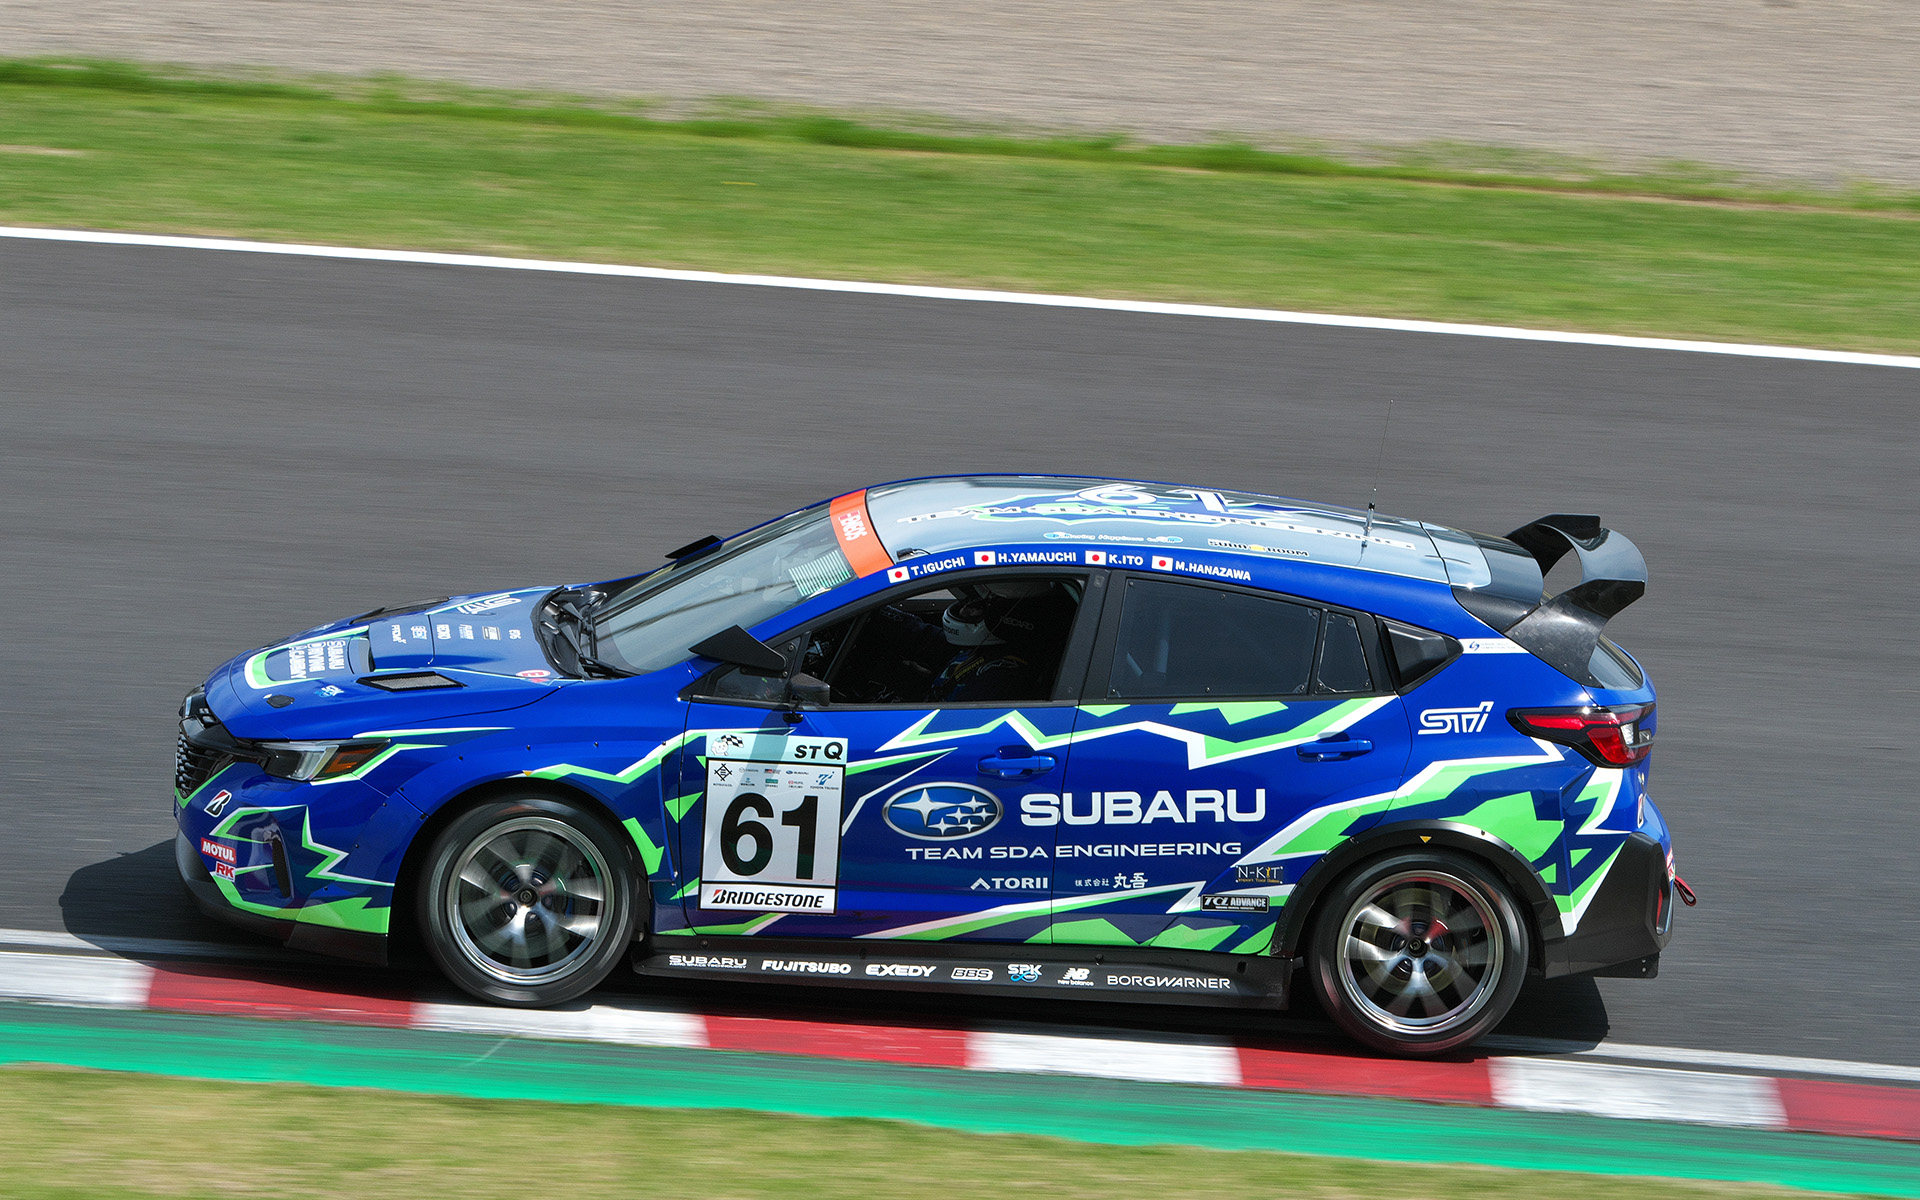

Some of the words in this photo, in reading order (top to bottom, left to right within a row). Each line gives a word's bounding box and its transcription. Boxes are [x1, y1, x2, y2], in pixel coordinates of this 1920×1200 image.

[998, 552, 1076, 563] H.YAMAUCHI
[1109, 554, 1143, 566] K.ITO
[911, 556, 965, 576] T.IGUCHI
[1175, 561, 1252, 581] M.HANAZAWA
[1020, 788, 1266, 827] SUBARU
[720, 792, 819, 880] 61
[202, 841, 235, 862] MOTUL
[905, 847, 983, 860] TEAM
[990, 846, 1049, 859] SDA
[1055, 842, 1241, 858] ENGINEERING
[216, 862, 234, 878] RK
[711, 889, 824, 908] BRIDGESTONE
[1230, 897, 1266, 907] ADVANCE
[669, 955, 747, 966] SUBARU
[761, 960, 851, 974] FUJITSUBO
[865, 964, 936, 977] EXEDY
[951, 967, 993, 981] BBS
[1007, 963, 1042, 976] SPK
[1107, 975, 1231, 989] BORGWARNER
